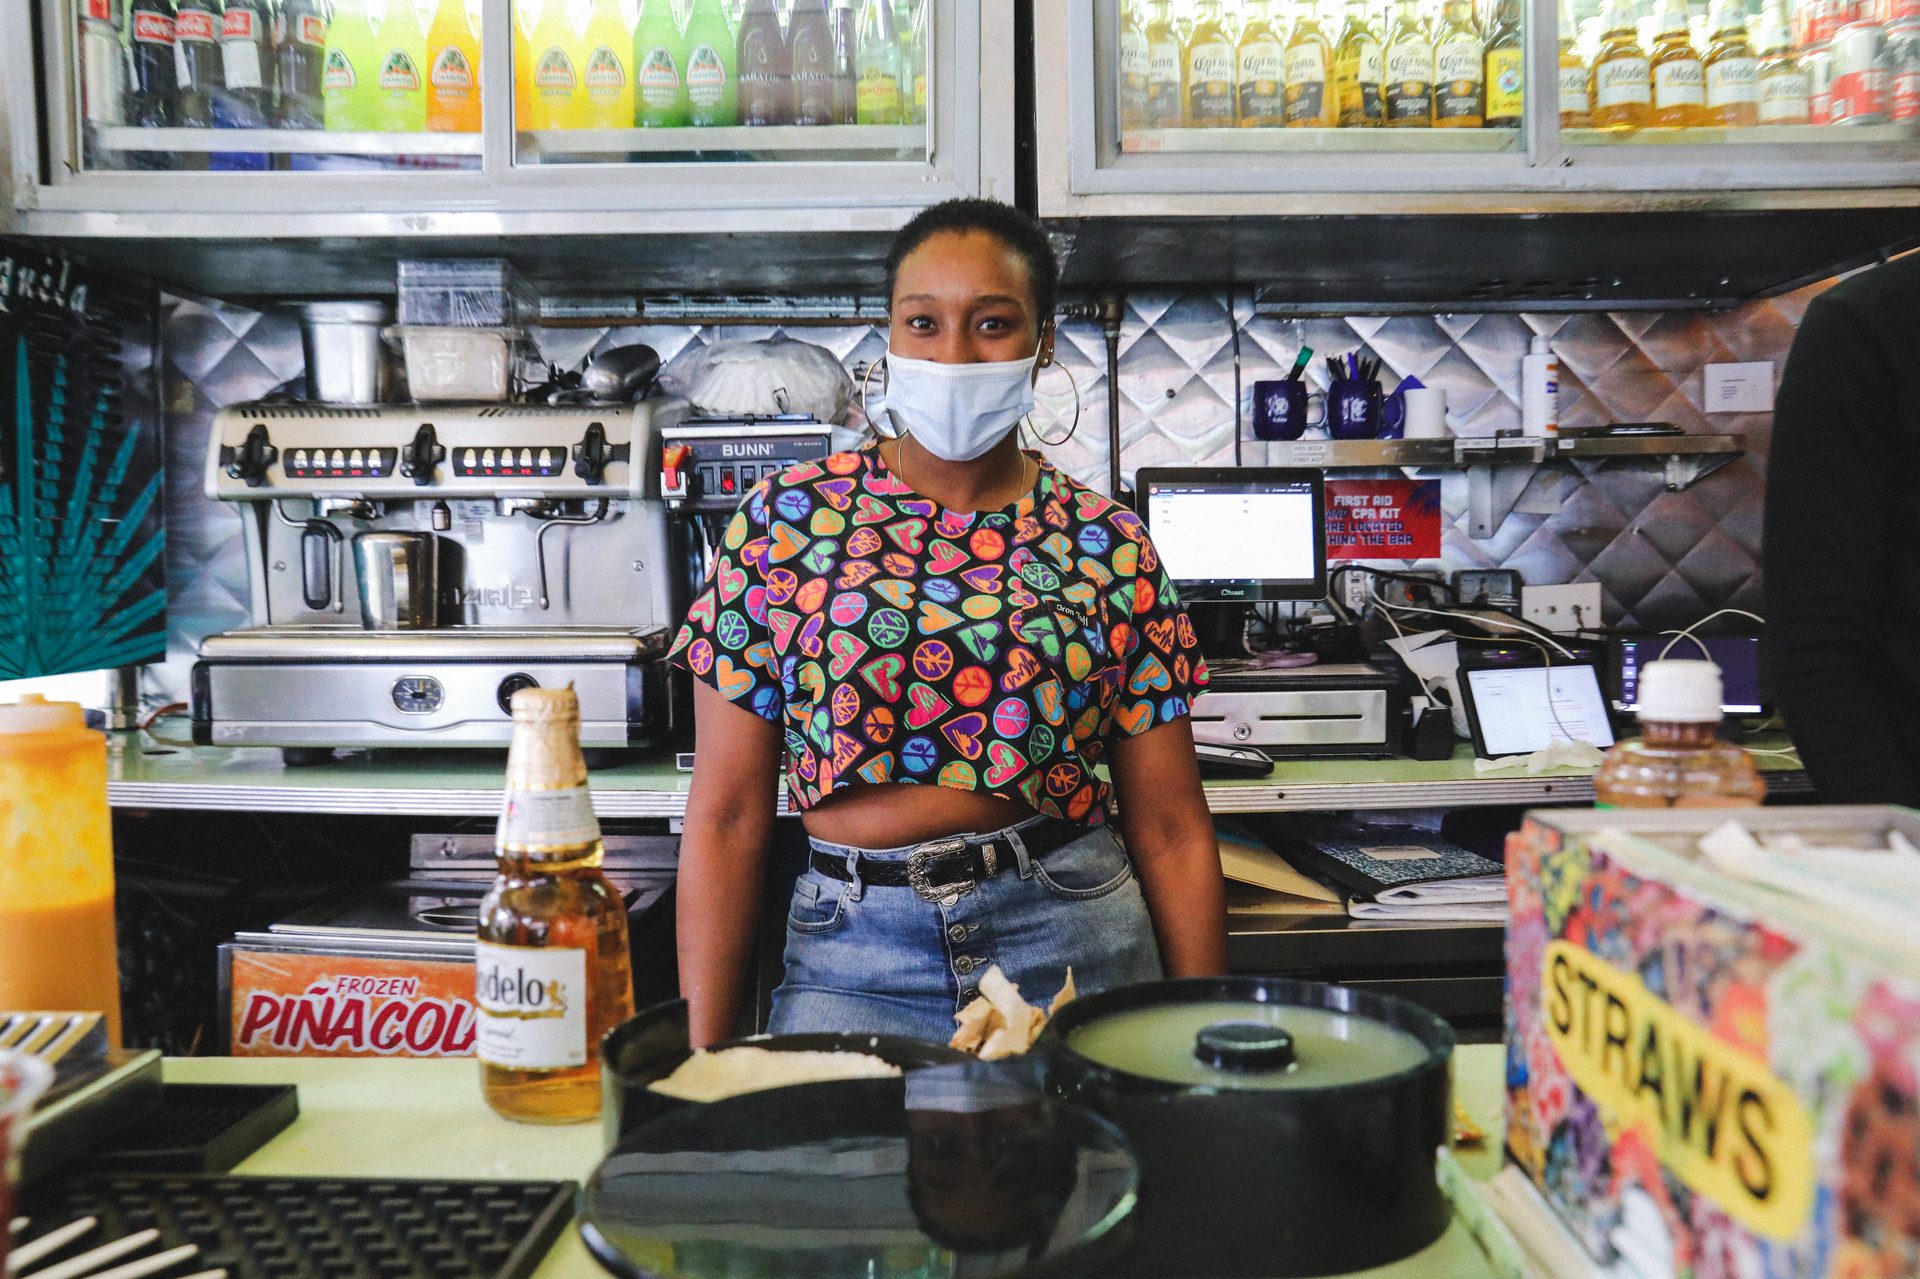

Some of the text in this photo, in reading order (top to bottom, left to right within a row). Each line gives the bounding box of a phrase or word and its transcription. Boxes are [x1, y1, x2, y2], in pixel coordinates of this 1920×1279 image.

[722, 443, 771, 457] BUNN
[1334, 495, 1393, 506] FIRST AID
[1352, 508, 1377, 519] CPR
[1379, 507, 1401, 519] KIT
[1349, 521, 1404, 532] LOCATED
[1325, 534, 1413, 546] HIND THE BAR
[336, 976, 416, 996] FROZEN
[239, 985, 365, 1048] PIÑA
[1549, 953, 1777, 1203] STRAWS
